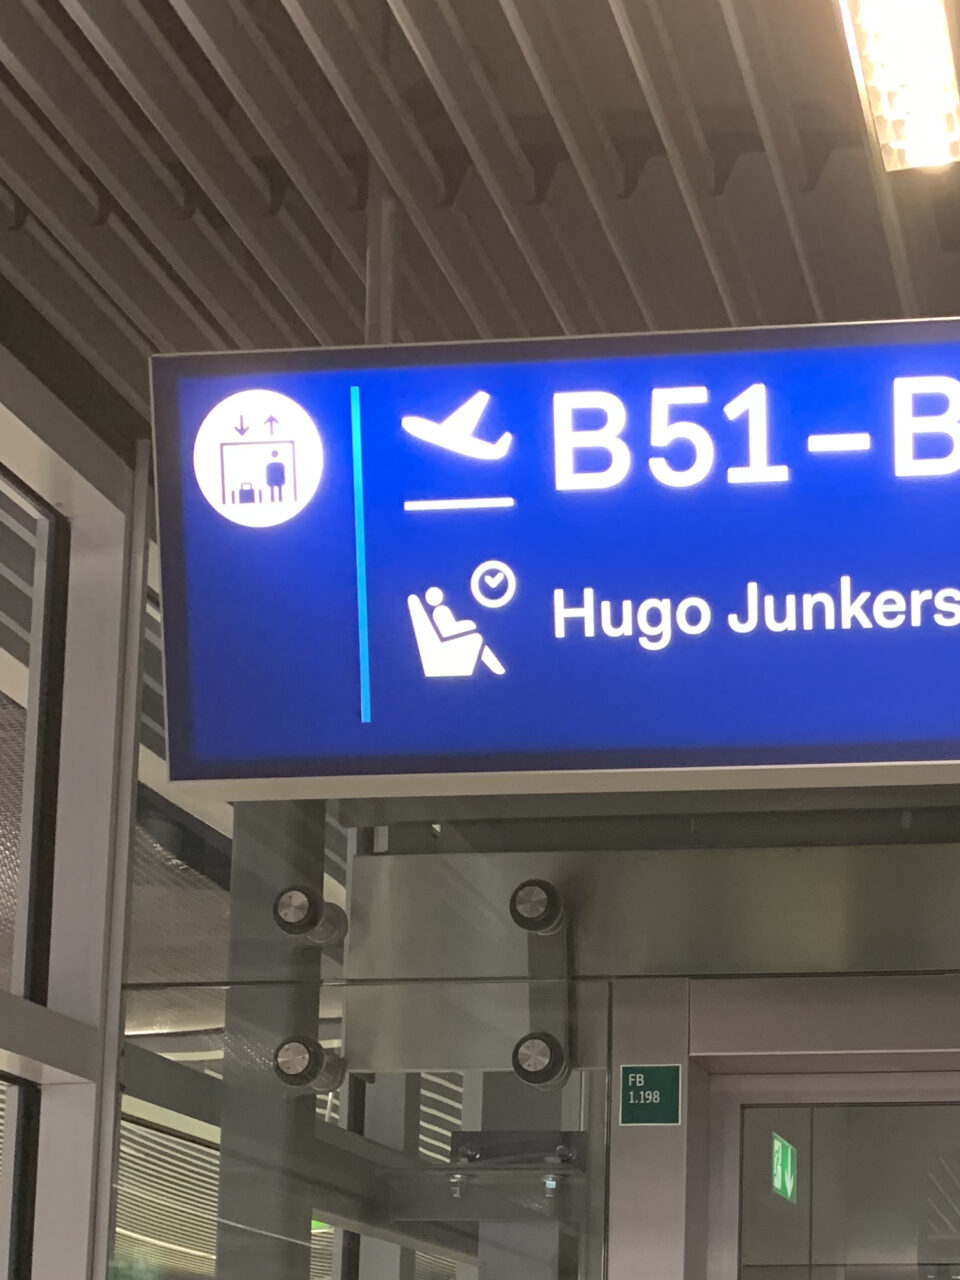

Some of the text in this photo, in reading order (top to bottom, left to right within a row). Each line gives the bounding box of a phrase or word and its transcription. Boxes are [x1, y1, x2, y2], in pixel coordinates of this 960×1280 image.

[552, 586, 714, 653] Hugo
[628, 1073, 645, 1087] FB
[628, 1090, 660, 1104] 1.198
